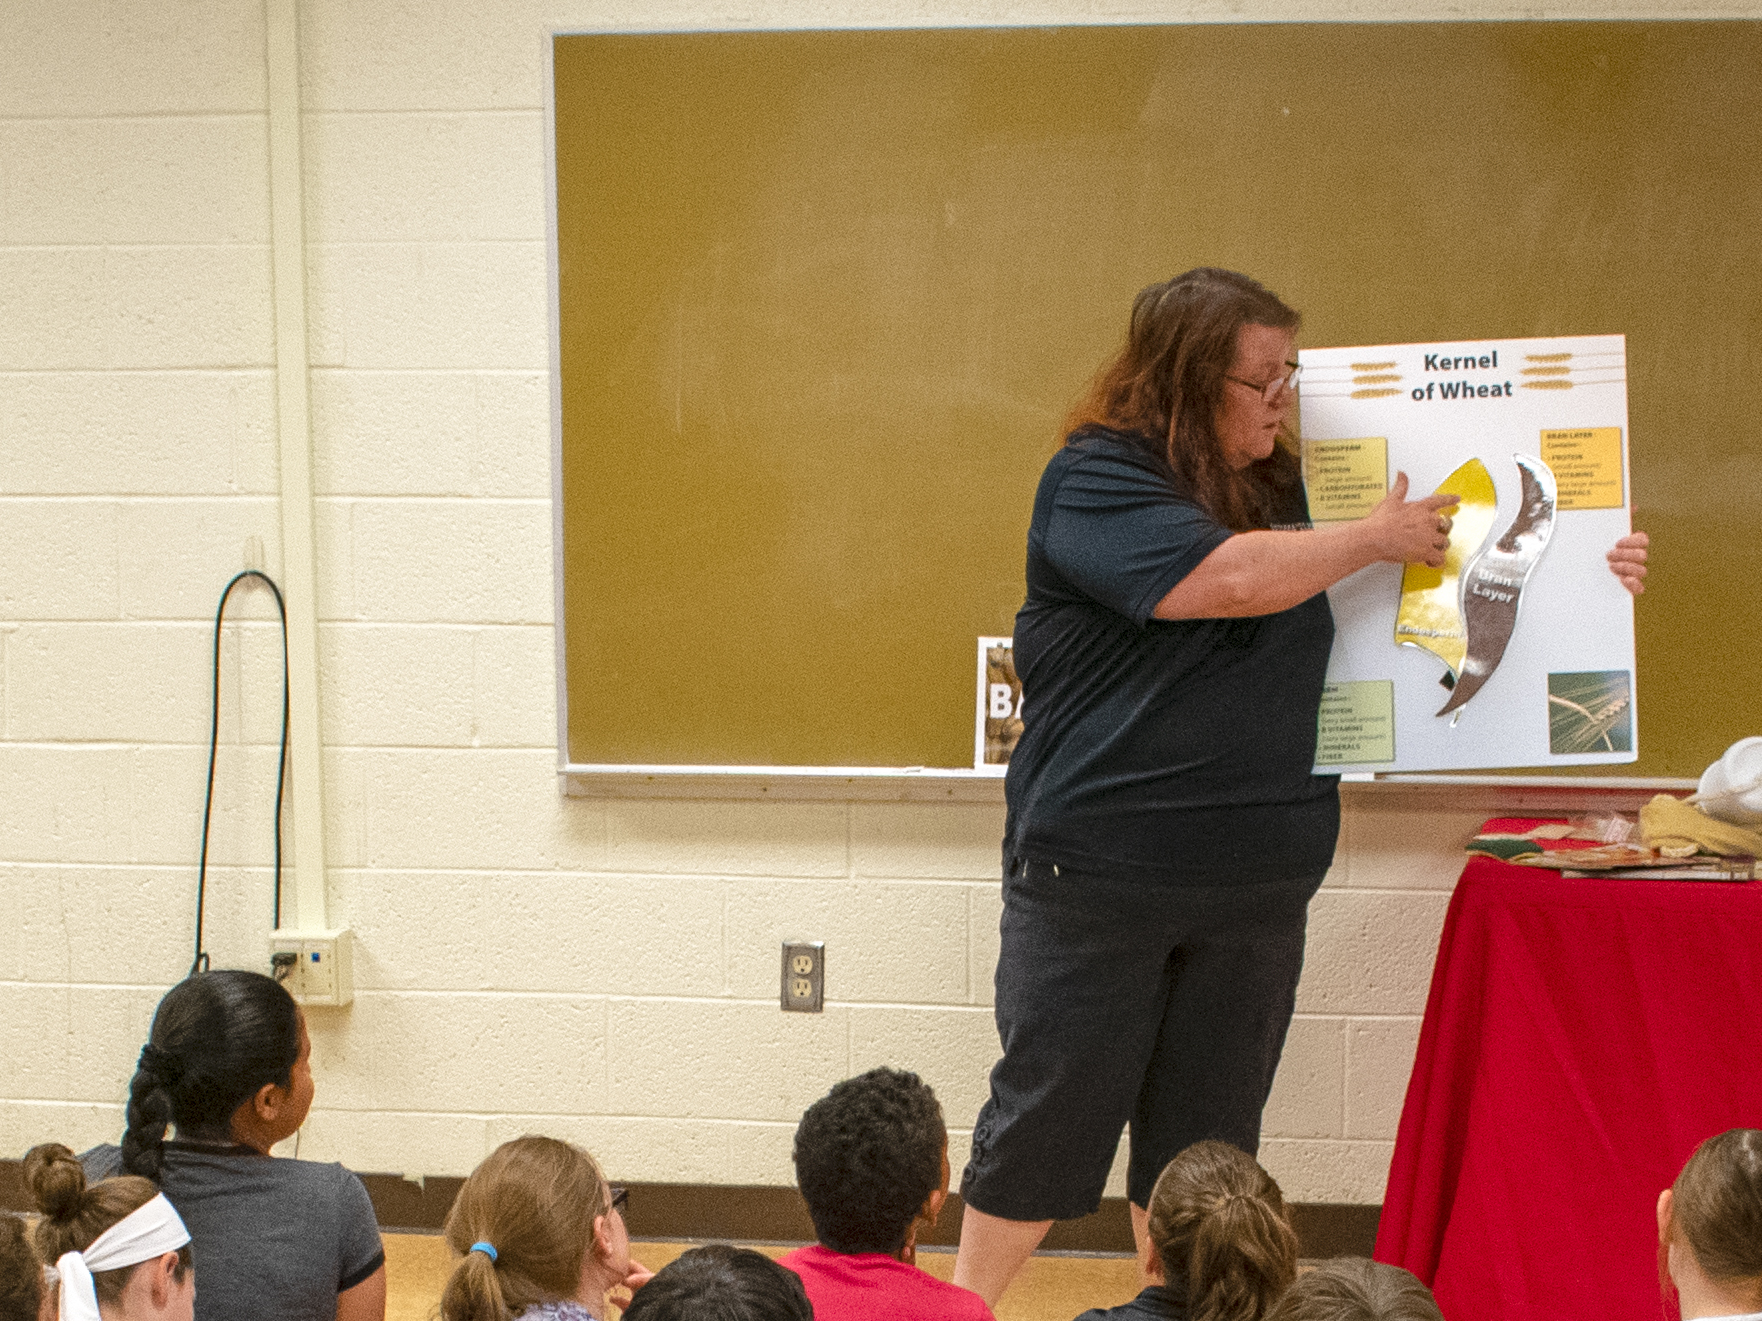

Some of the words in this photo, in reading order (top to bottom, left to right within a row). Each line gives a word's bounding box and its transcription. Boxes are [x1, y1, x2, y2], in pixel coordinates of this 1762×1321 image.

[1424, 350, 1498, 371] Kernel
[1411, 383, 1435, 402] of
[1439, 380, 1513, 401] Wheat
[1472, 583, 1516, 604] Layer
